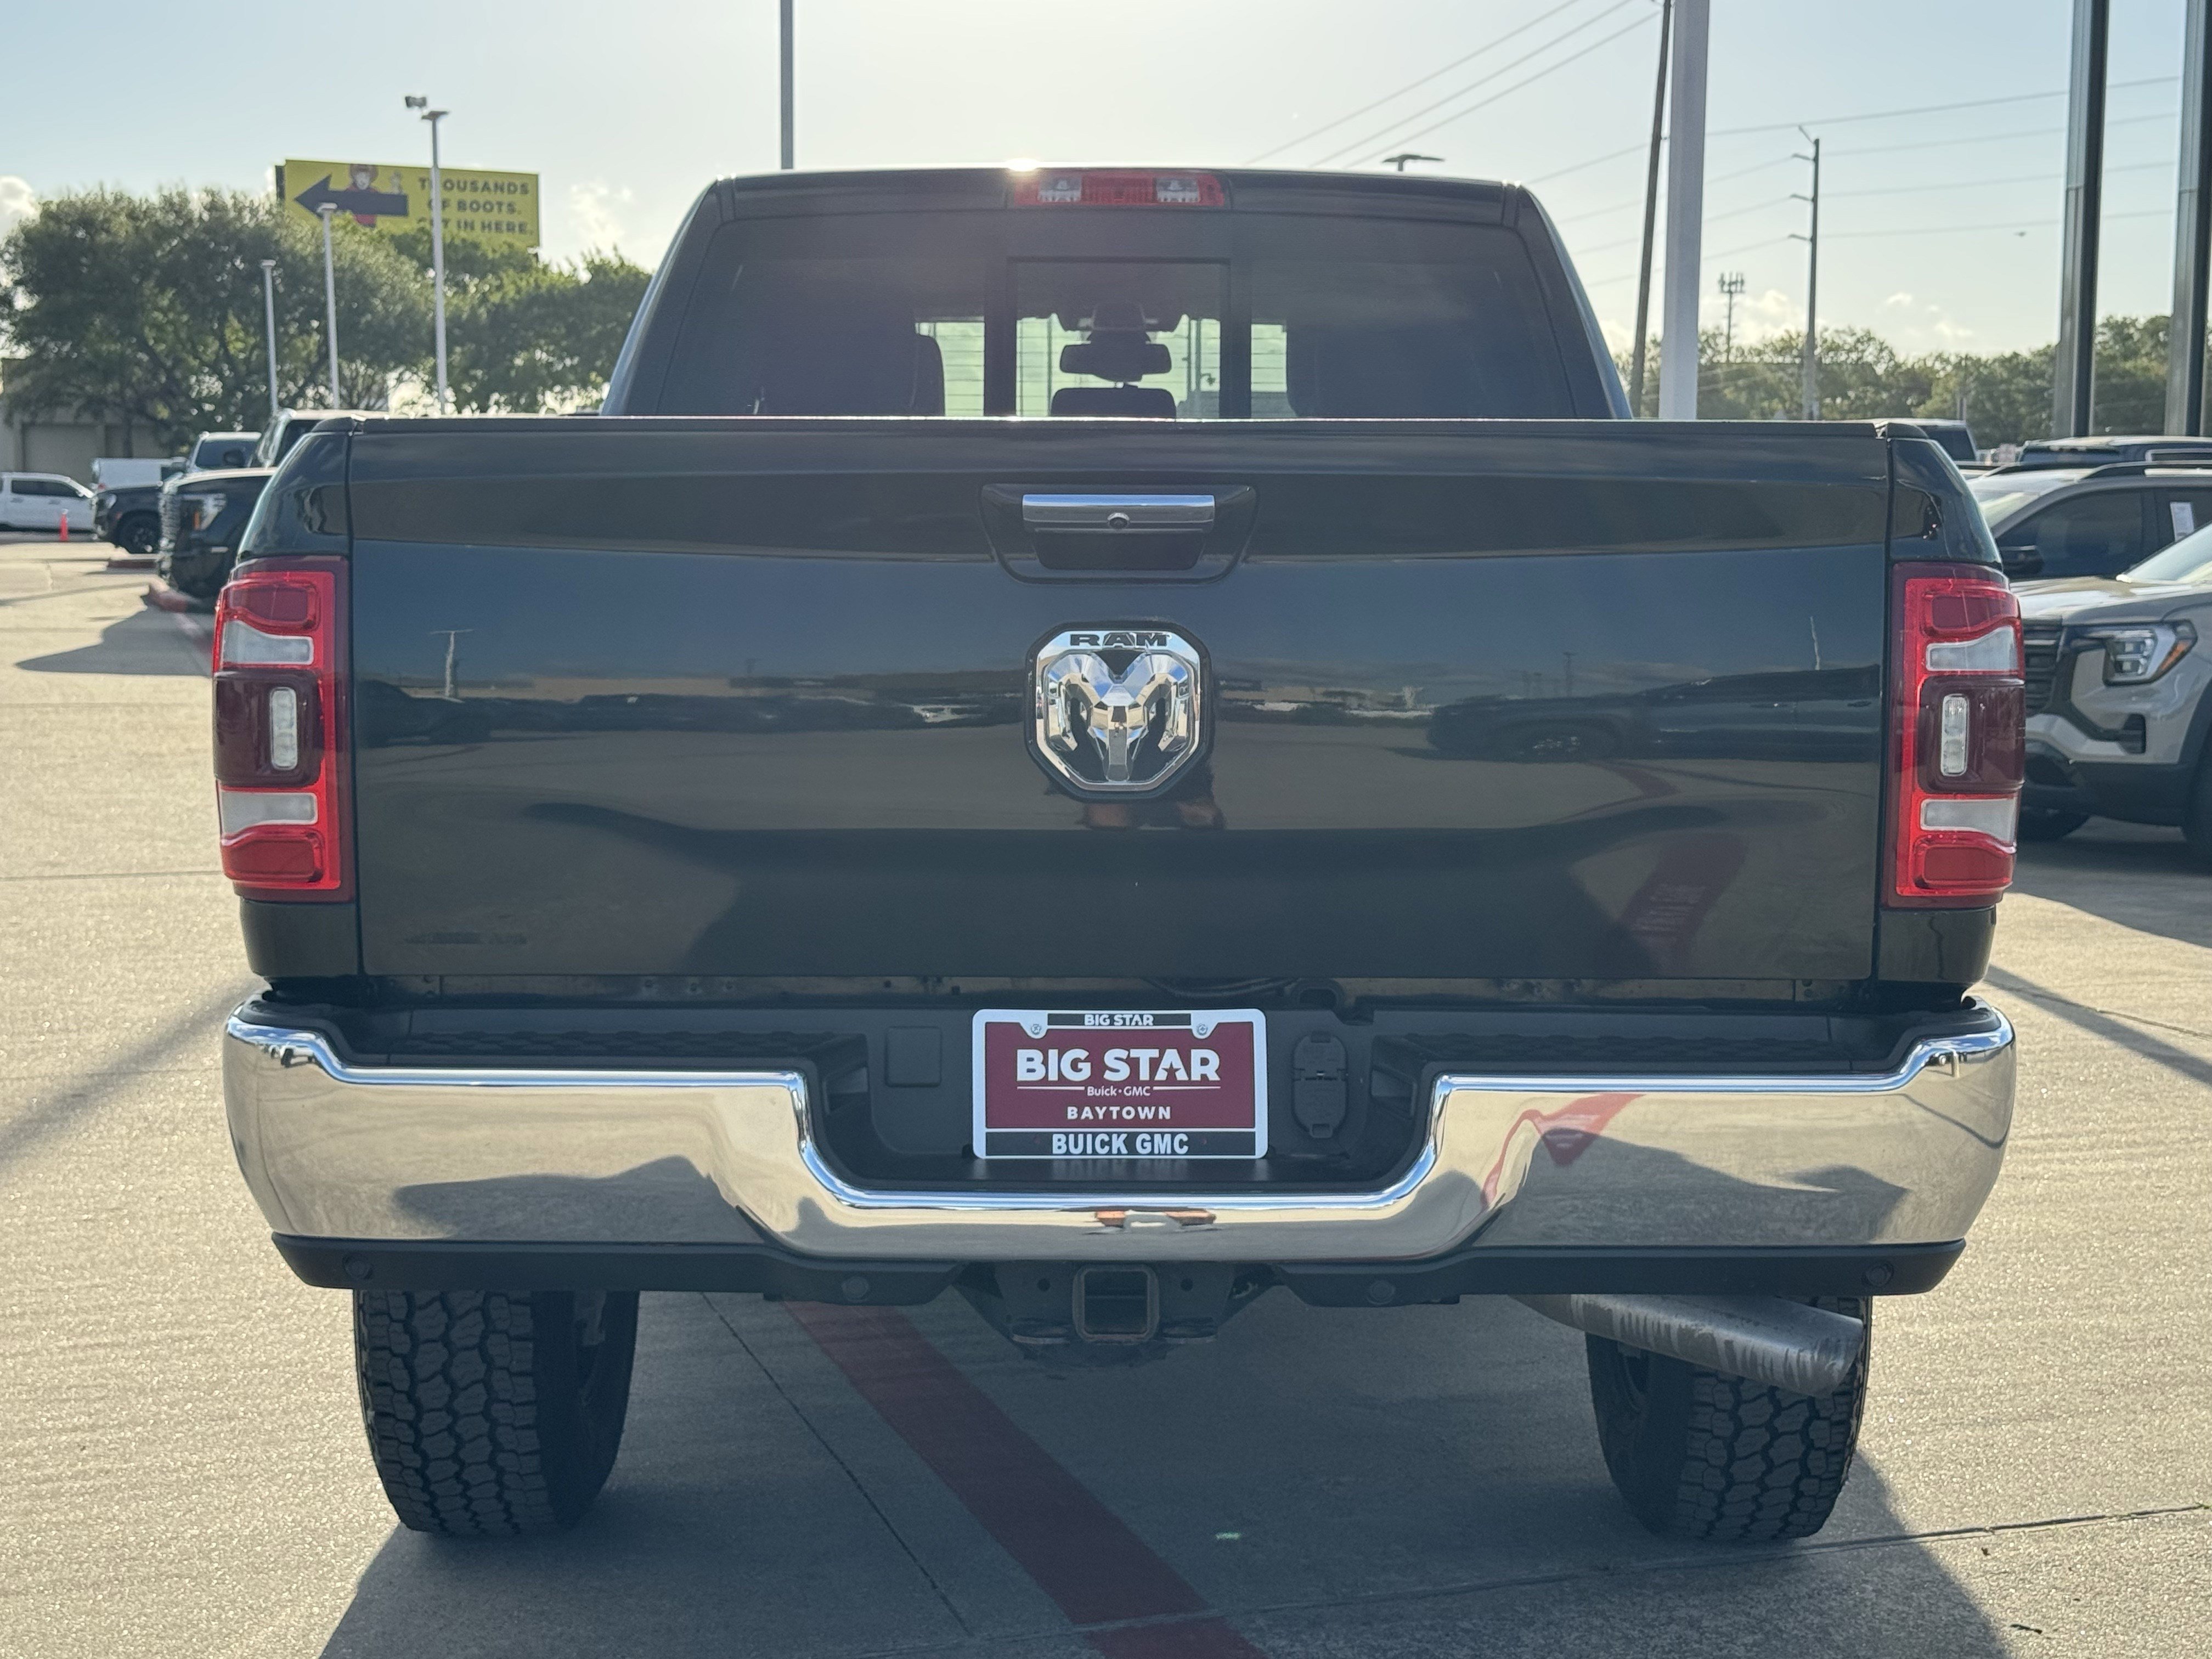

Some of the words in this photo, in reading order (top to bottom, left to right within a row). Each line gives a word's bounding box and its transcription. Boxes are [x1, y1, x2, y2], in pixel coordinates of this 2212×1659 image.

[419, 177, 529, 195] TOUSANDS
[1070, 633, 1168, 646] RAM
[1084, 1014, 1110, 1026] BIG
[1113, 1014, 1154, 1026] STAR
[1017, 1048, 1091, 1081] BIG
[1103, 1048, 1221, 1081] STAR
[1067, 1106, 1171, 1120] BAYTOWN
[1052, 1133, 1128, 1154] BUICK
[1136, 1133, 1189, 1154] GMC
